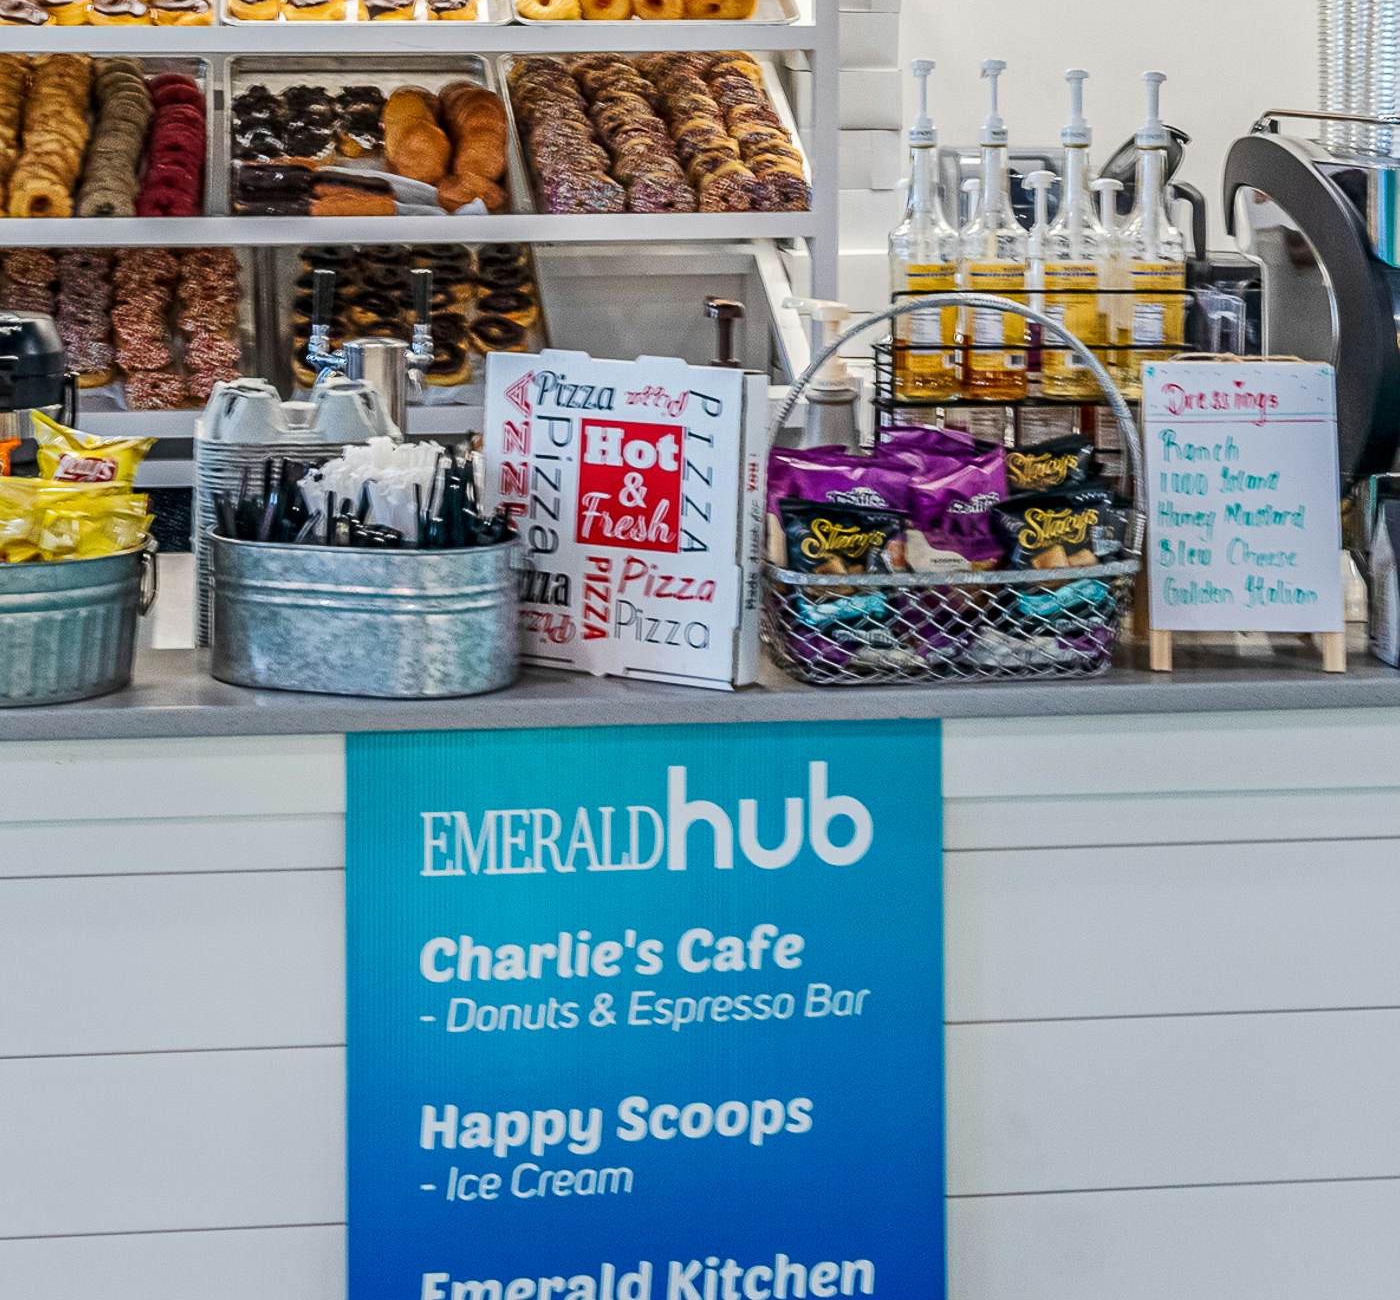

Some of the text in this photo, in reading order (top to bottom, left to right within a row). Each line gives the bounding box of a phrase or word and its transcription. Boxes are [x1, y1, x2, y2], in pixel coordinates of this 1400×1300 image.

[534, 370, 615, 411] Pizza
[1161, 380, 1279, 427] Dressings
[584, 426, 679, 472] Hot
[1158, 429, 1239, 462] Ranch
[529, 414, 573, 556] Pizza
[618, 472, 648, 508] &
[681, 390, 723, 553] PIZZA
[1006, 452, 1079, 486] Stacy's
[1160, 472, 1209, 496] 1000
[581, 492, 675, 544] Fresh
[801, 517, 887, 559] Stacy's
[1018, 507, 1099, 550] Stacy's
[1158, 501, 1306, 541] Honey Mustard
[1226, 537, 1297, 566] Cheese
[582, 555, 612, 640] PIZZA
[617, 555, 716, 602] Pizza
[1163, 574, 1318, 607] Golden Italian
[613, 599, 711, 649] Pizza
[420, 923, 805, 983] Charlie's Cafe
[446, 983, 872, 1033] Donuts & Espresso Bar
[420, 1095, 814, 1158] Happy Scoops
[446, 1163, 634, 1202] Ice Cream
[420, 1253, 876, 1300] Emerald Kitchen
